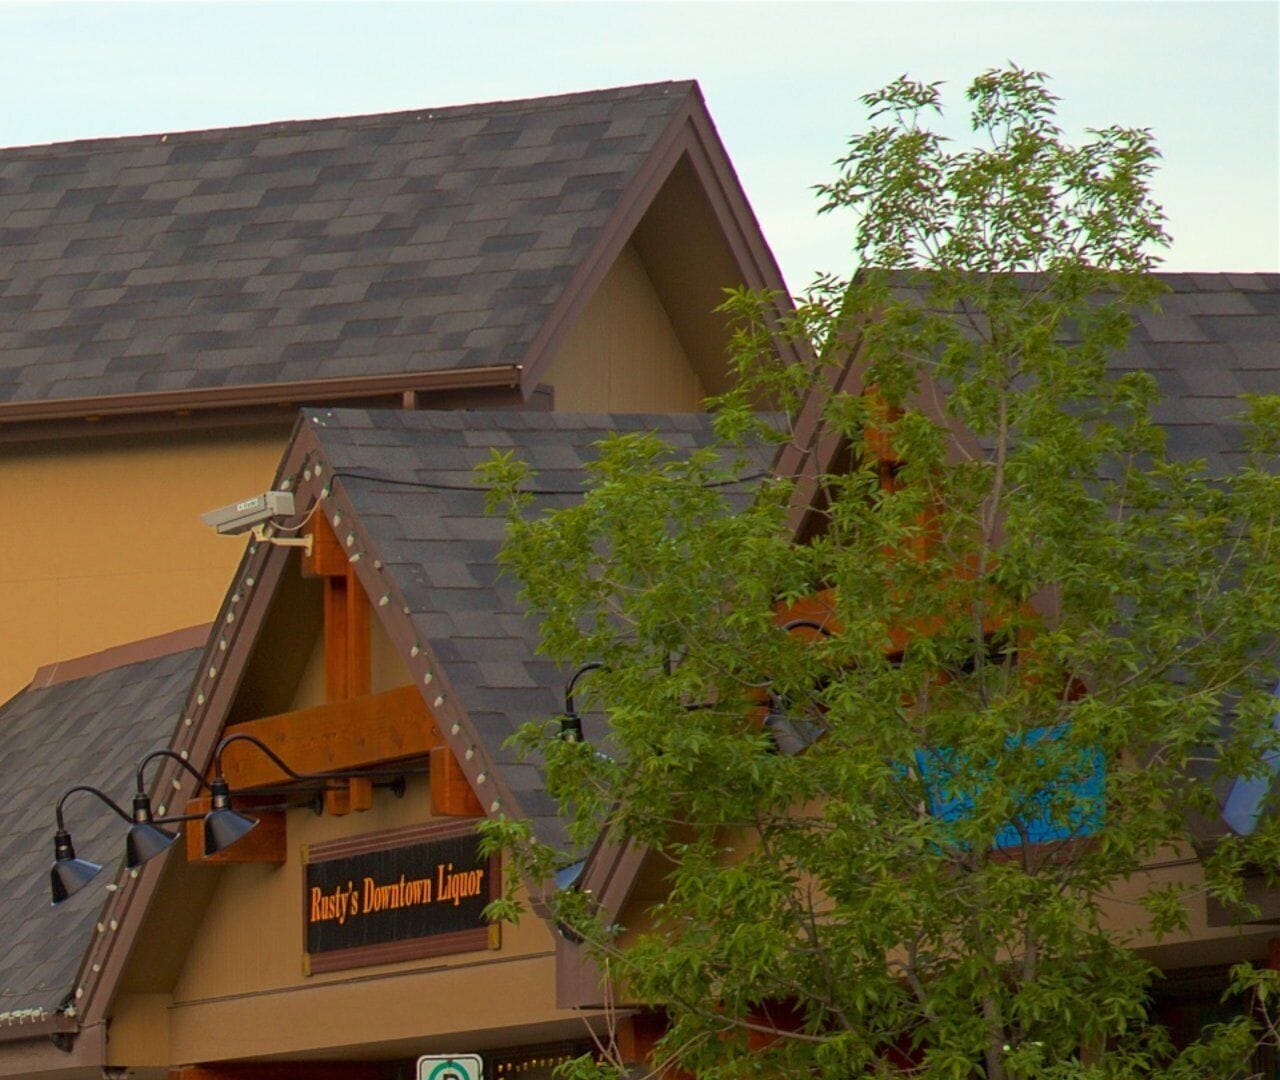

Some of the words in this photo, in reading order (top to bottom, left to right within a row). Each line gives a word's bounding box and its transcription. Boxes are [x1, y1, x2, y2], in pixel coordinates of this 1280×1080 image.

[310, 880, 359, 925] Rusty's
[362, 874, 432, 914] Downtown
[437, 863, 484, 907] Liquor
